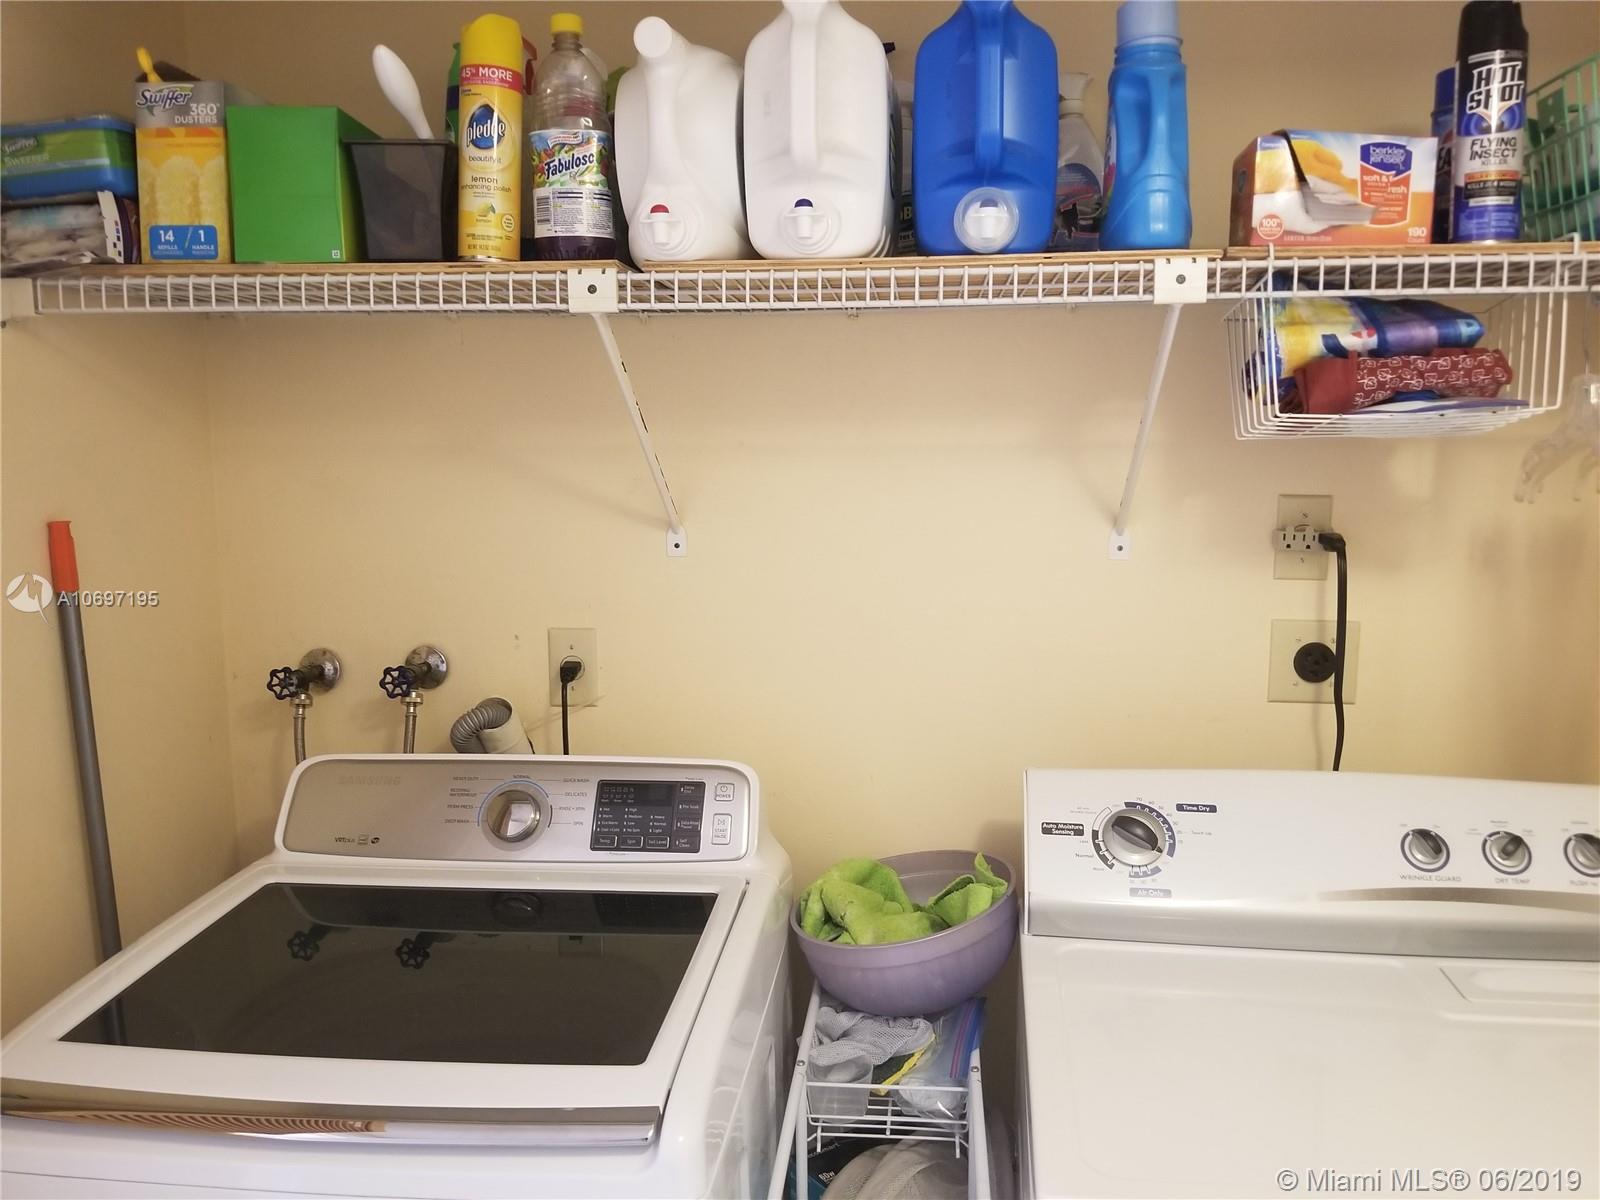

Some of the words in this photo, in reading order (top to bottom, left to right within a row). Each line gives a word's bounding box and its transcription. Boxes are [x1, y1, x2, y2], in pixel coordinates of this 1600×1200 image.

[479, 66, 513, 82] MORE
[137, 87, 192, 111] Swiffer
[175, 115, 217, 124] DUSTERS
[1471, 137, 1517, 151] FLYING
[1470, 148, 1517, 160] INSECT
[471, 175, 498, 184] lemon
[1363, 175, 1379, 183] soft
[493, 184, 512, 193] polish
[159, 229, 175, 242] 14
[198, 229, 205, 242] 1
[1408, 226, 1426, 236] 190
[1182, 804, 1196, 812] Time
[1198, 805, 1210, 813] Dry
[1058, 823, 1083, 831] Moisture
[1052, 828, 1074, 836] Sensing
[1399, 874, 1432, 882] WRINKLE
